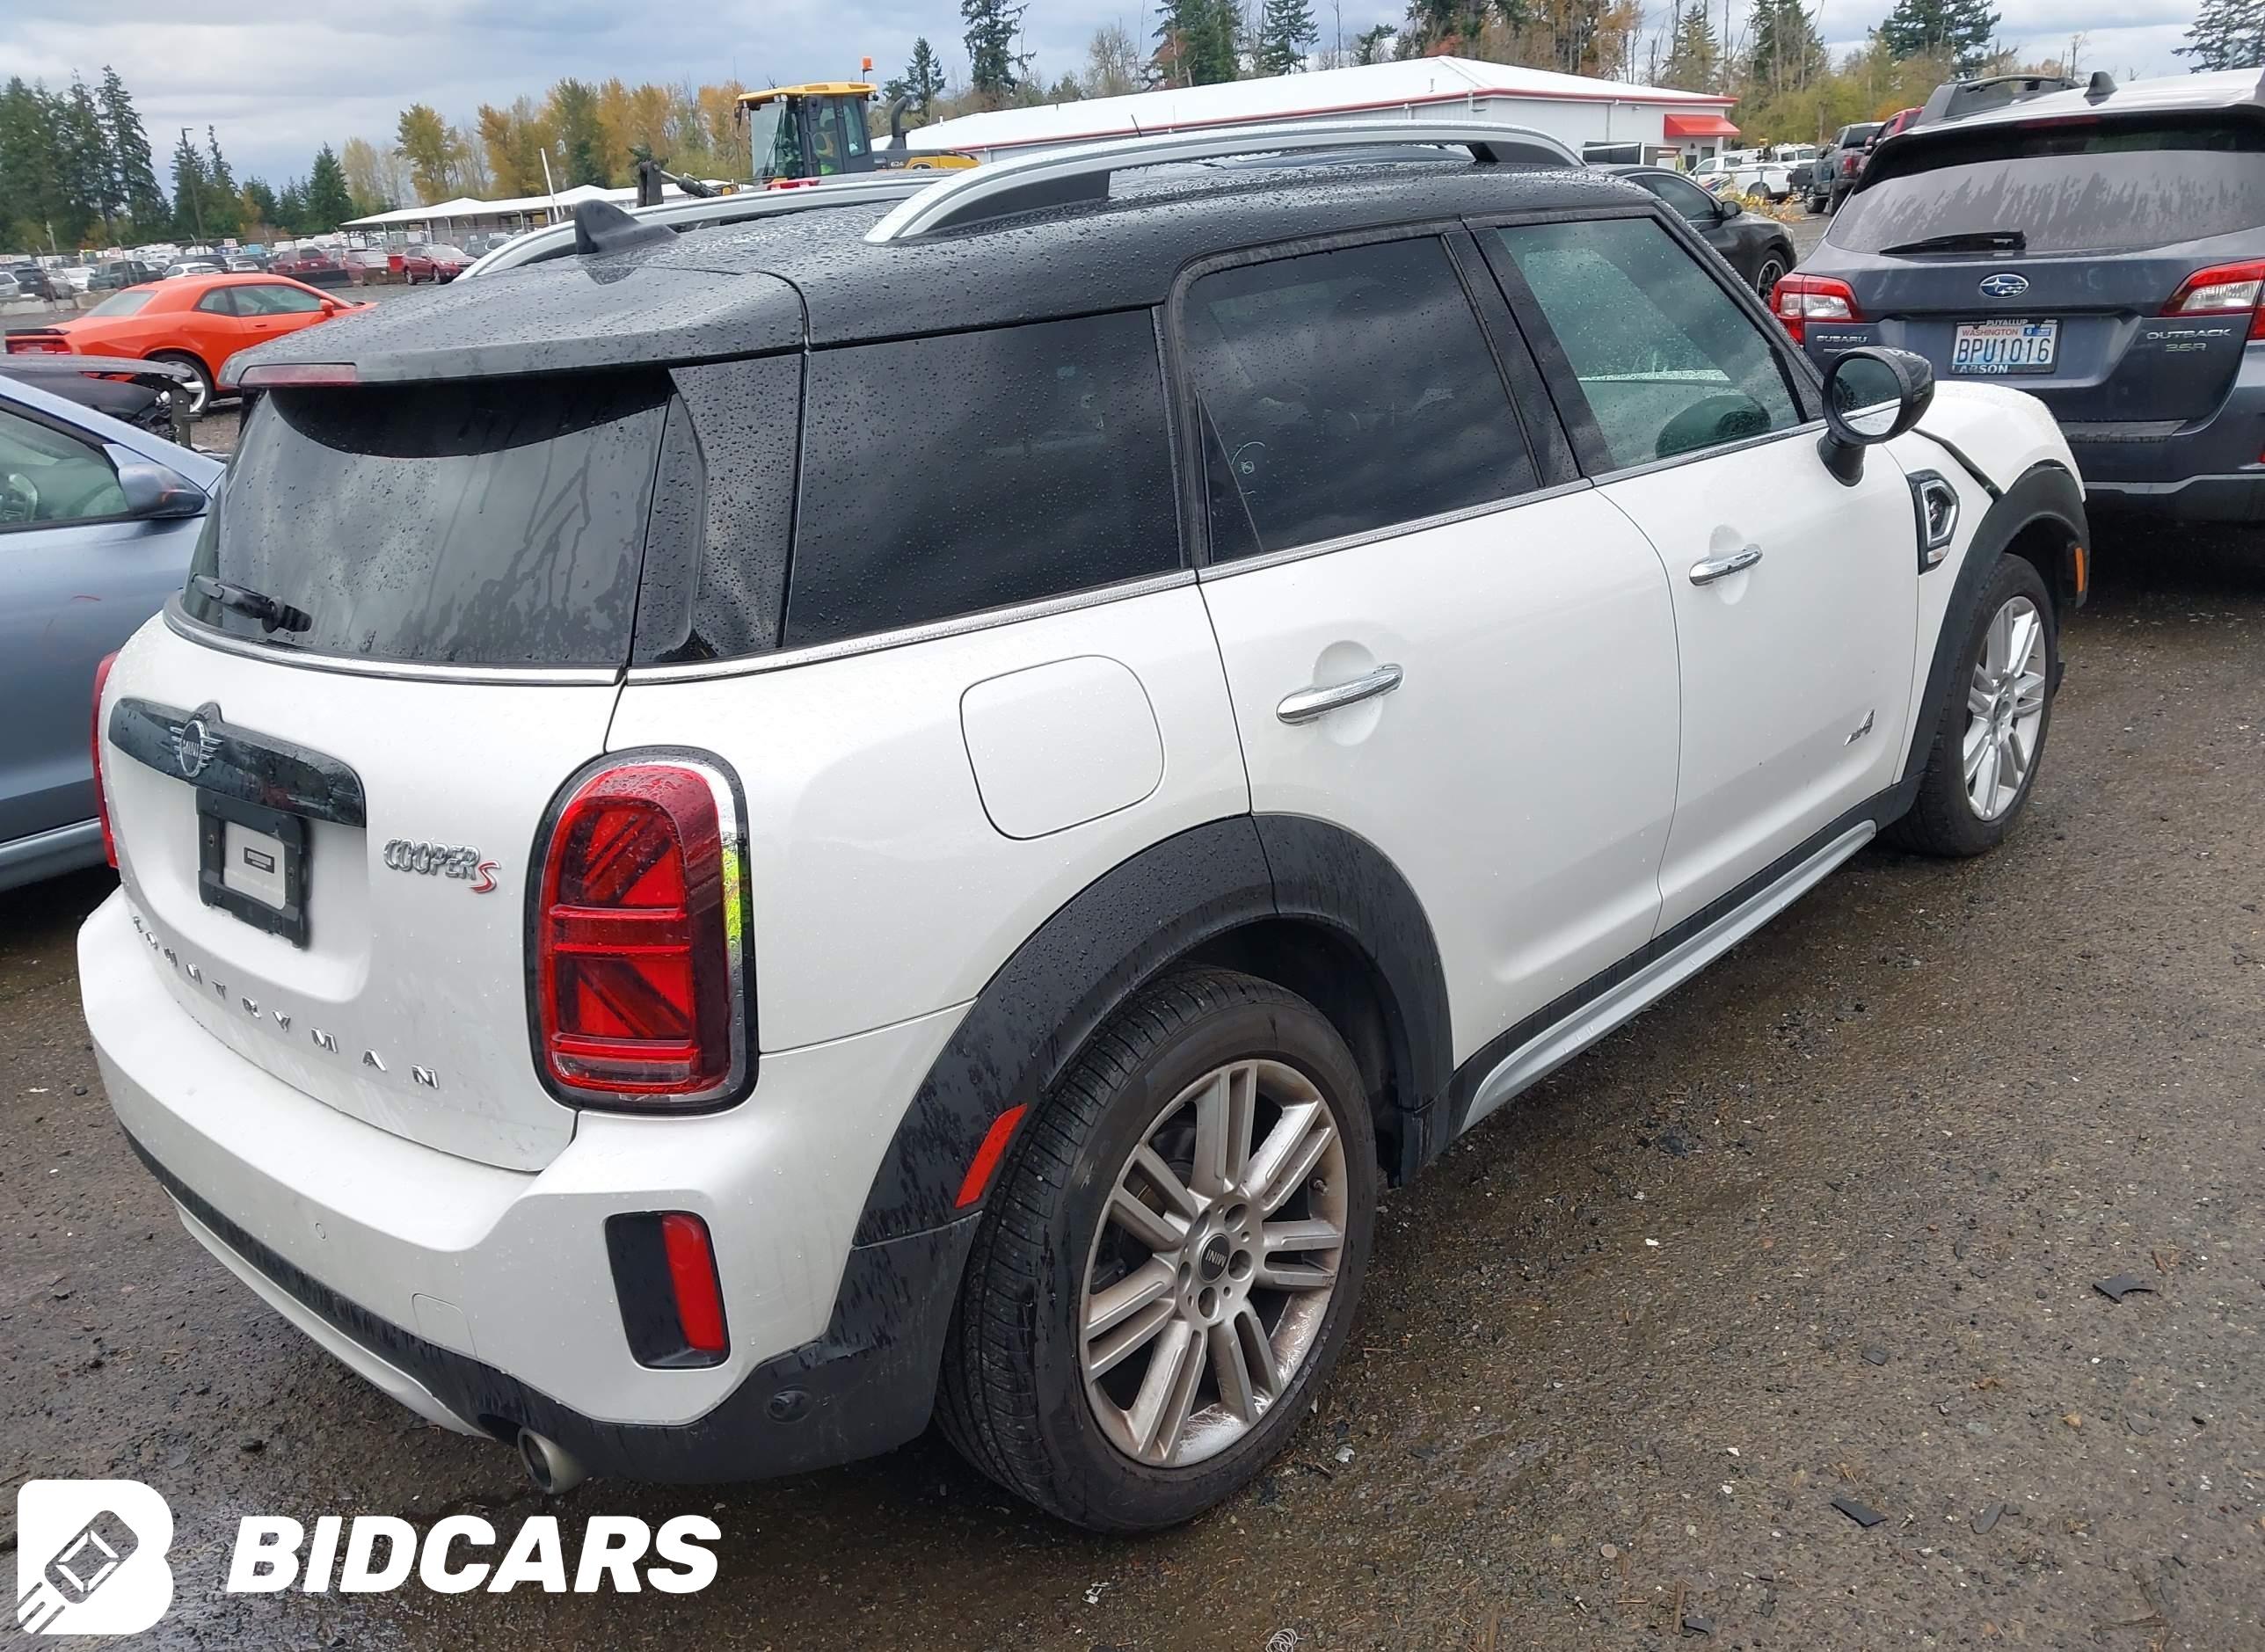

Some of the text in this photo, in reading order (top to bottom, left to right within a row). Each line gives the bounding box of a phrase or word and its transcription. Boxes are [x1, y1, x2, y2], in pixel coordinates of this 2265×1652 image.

[2146, 329, 2232, 339] OUTBACK
[1957, 338, 2050, 363] BPU1016
[183, 739, 200, 757] MINI
[383, 837, 480, 880] COOPER
[132, 916, 439, 1089] COUNTRYMAN
[1205, 1248, 1227, 1267] MINI
